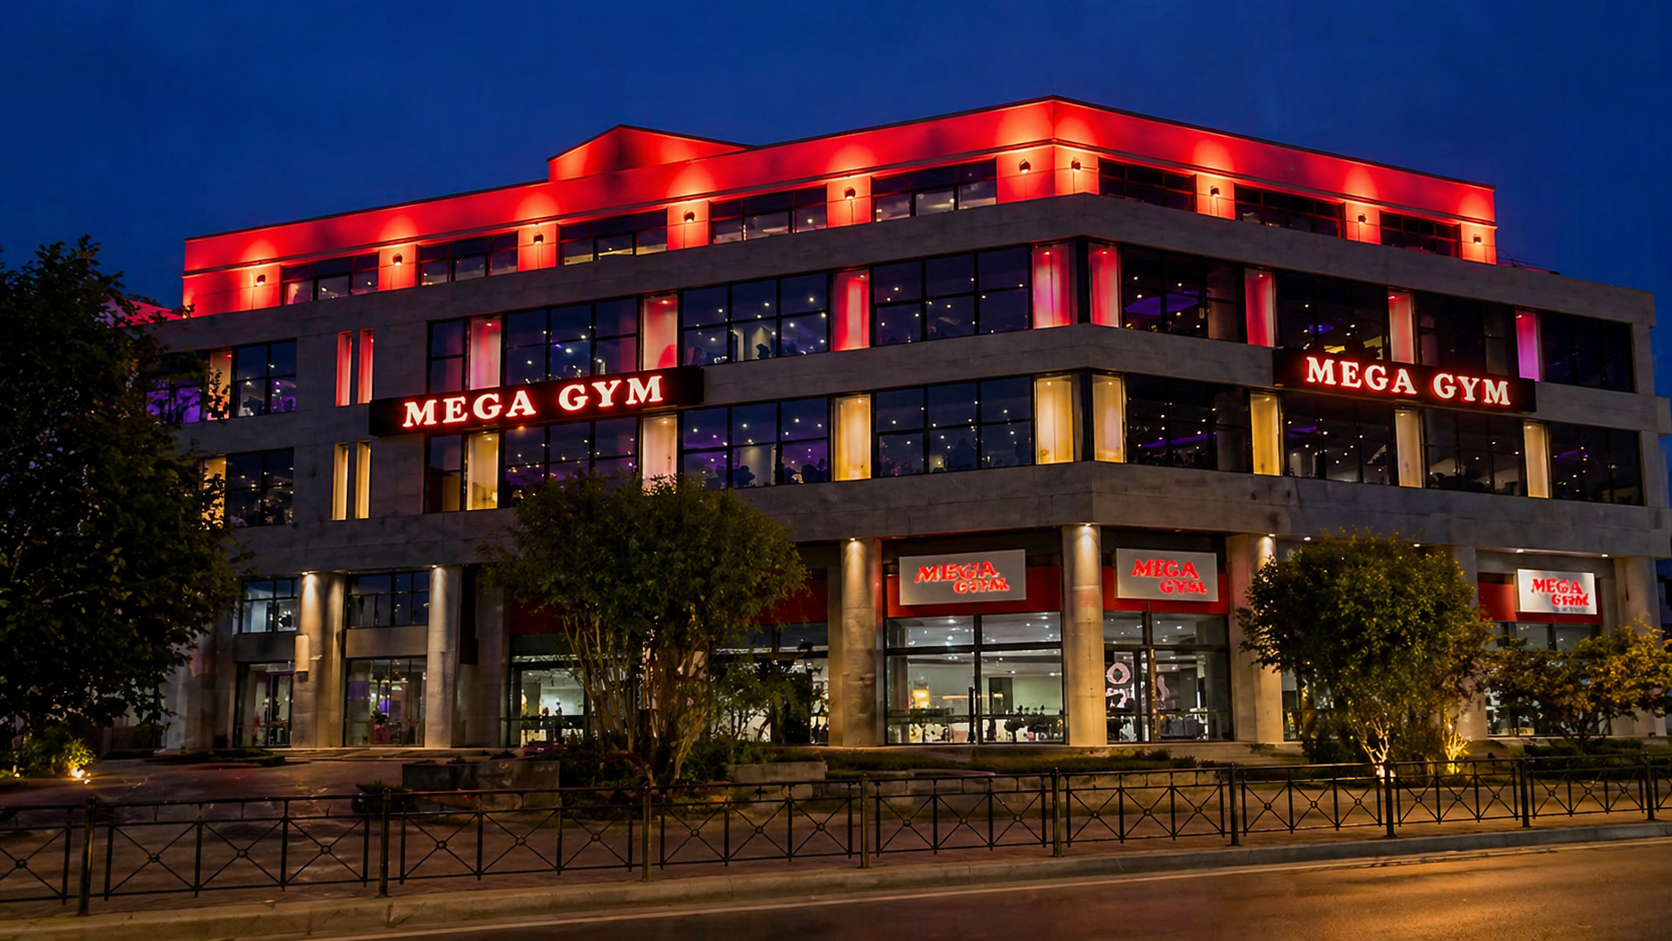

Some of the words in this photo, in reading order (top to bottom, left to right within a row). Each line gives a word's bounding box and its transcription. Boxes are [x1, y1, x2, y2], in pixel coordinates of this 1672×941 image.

[402, 390, 536, 427] MEGA
[558, 375, 663, 411] GYM
[1306, 356, 1417, 394] MEGA
[1433, 373, 1511, 405] GYM
[1531, 578, 1583, 595] MEGA
